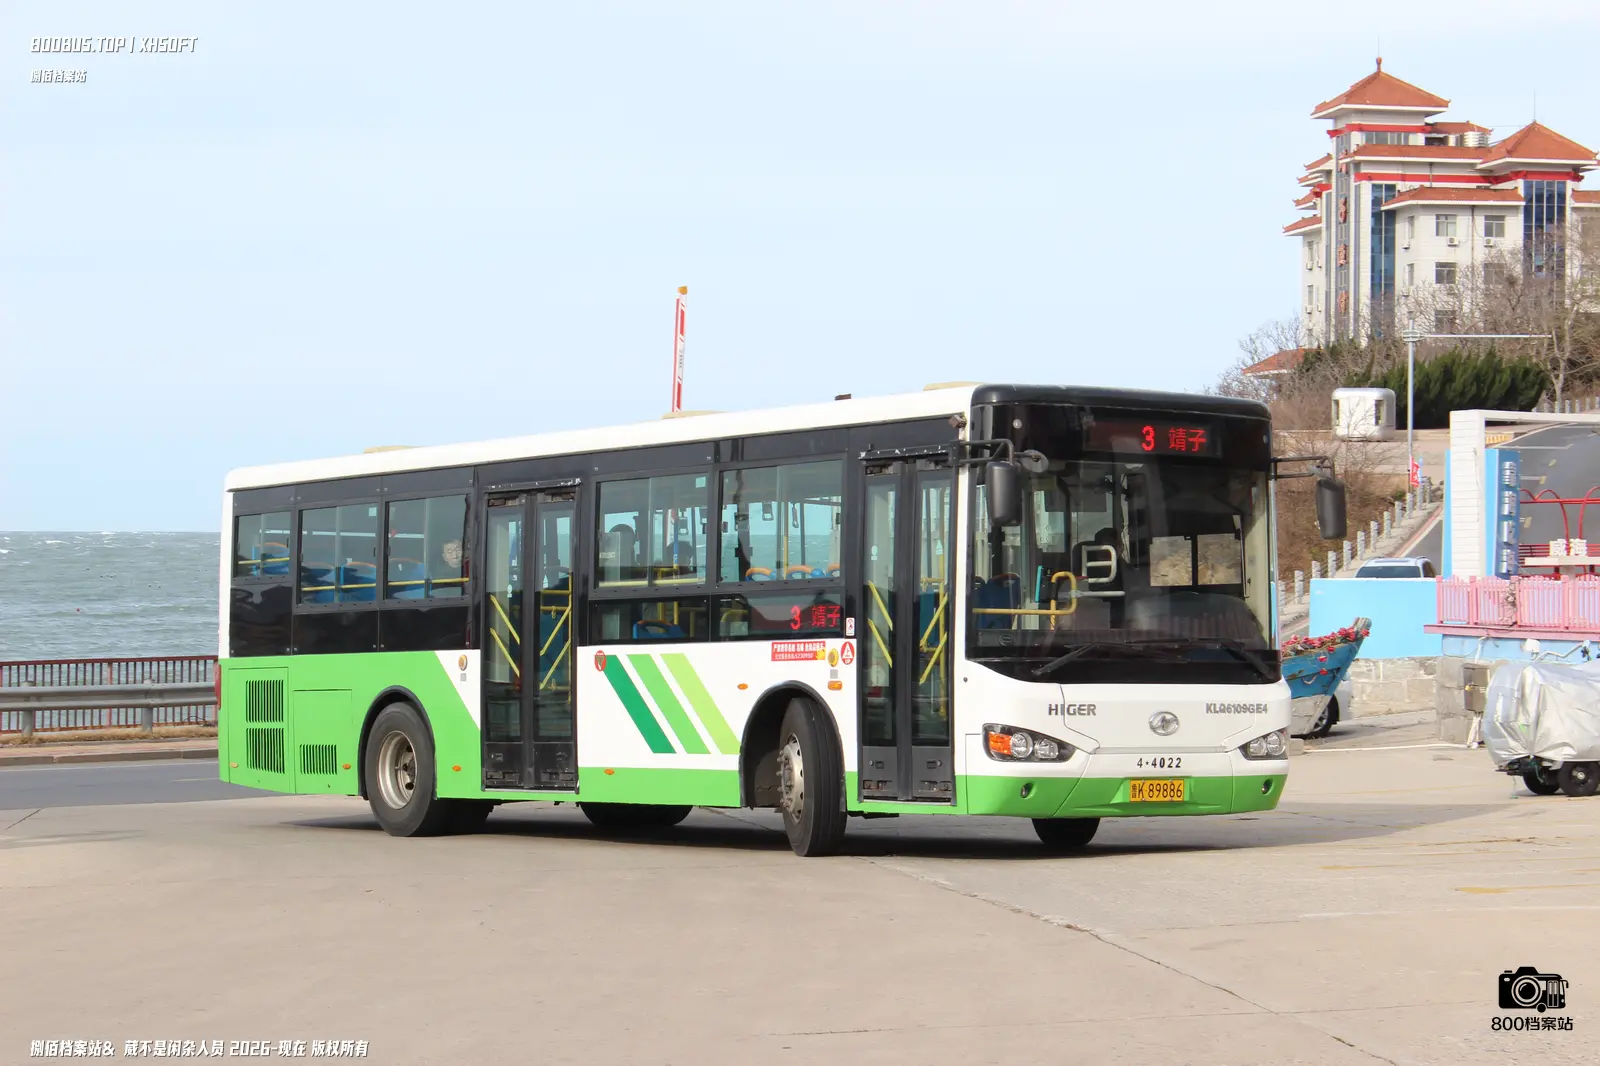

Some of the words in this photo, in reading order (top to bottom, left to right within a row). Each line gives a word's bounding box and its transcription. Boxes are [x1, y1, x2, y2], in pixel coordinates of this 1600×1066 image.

[1141, 425, 1155, 451] 3
[1168, 427, 1207, 452] 靖子
[790, 605, 801, 630] 3
[811, 605, 841, 628] 靖子
[1048, 703, 1097, 716] HIGER
[1205, 702, 1269, 715] KLQ6109GE4
